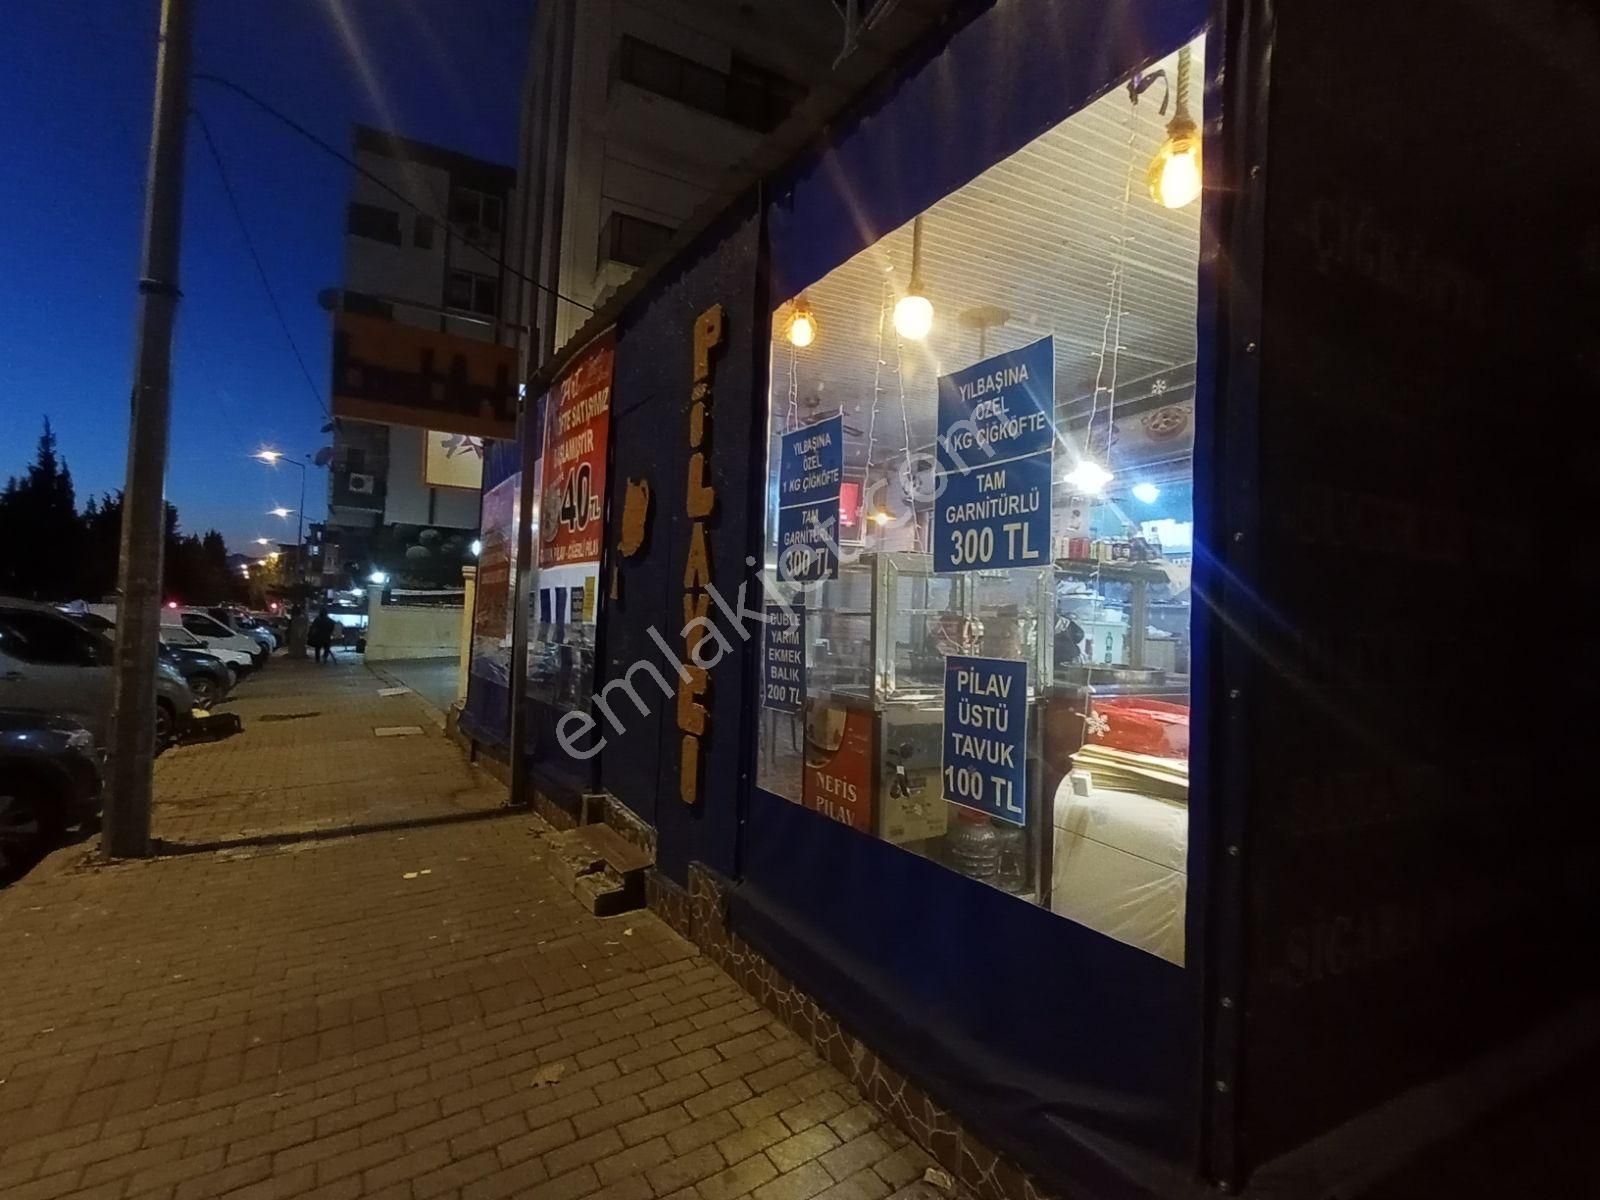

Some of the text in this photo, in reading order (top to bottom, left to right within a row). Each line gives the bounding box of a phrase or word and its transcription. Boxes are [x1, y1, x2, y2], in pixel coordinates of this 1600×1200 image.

[959, 364, 1029, 401] YILBAŞINA
[976, 396, 1009, 421] ÖZEL
[793, 433, 832, 456] YILBAŞINA
[953, 432, 973, 452] KG
[976, 411, 1046, 450] ÇİĞKÖFTE
[803, 455, 822, 471] ÖZEL
[560, 462, 592, 529] 40
[789, 478, 801, 492] KG
[977, 470, 1006, 493] TAM
[802, 509, 819, 526] TAM
[946, 488, 1039, 524] GARNİTÜRLÜ
[951, 522, 1039, 564] 300 TL
[786, 548, 833, 576] 300 TL
[771, 630, 800, 645] YARIM
[768, 648, 801, 664] EKMEK
[770, 666, 800, 682] BALIK
[957, 667, 1012, 698] PİLAV
[767, 684, 802, 705] 200 TL
[958, 698, 1009, 732] ÜSTÜ
[952, 732, 1015, 769] TAVUK
[816, 771, 857, 803] NEFİS
[945, 765, 1023, 813] 100 TL
